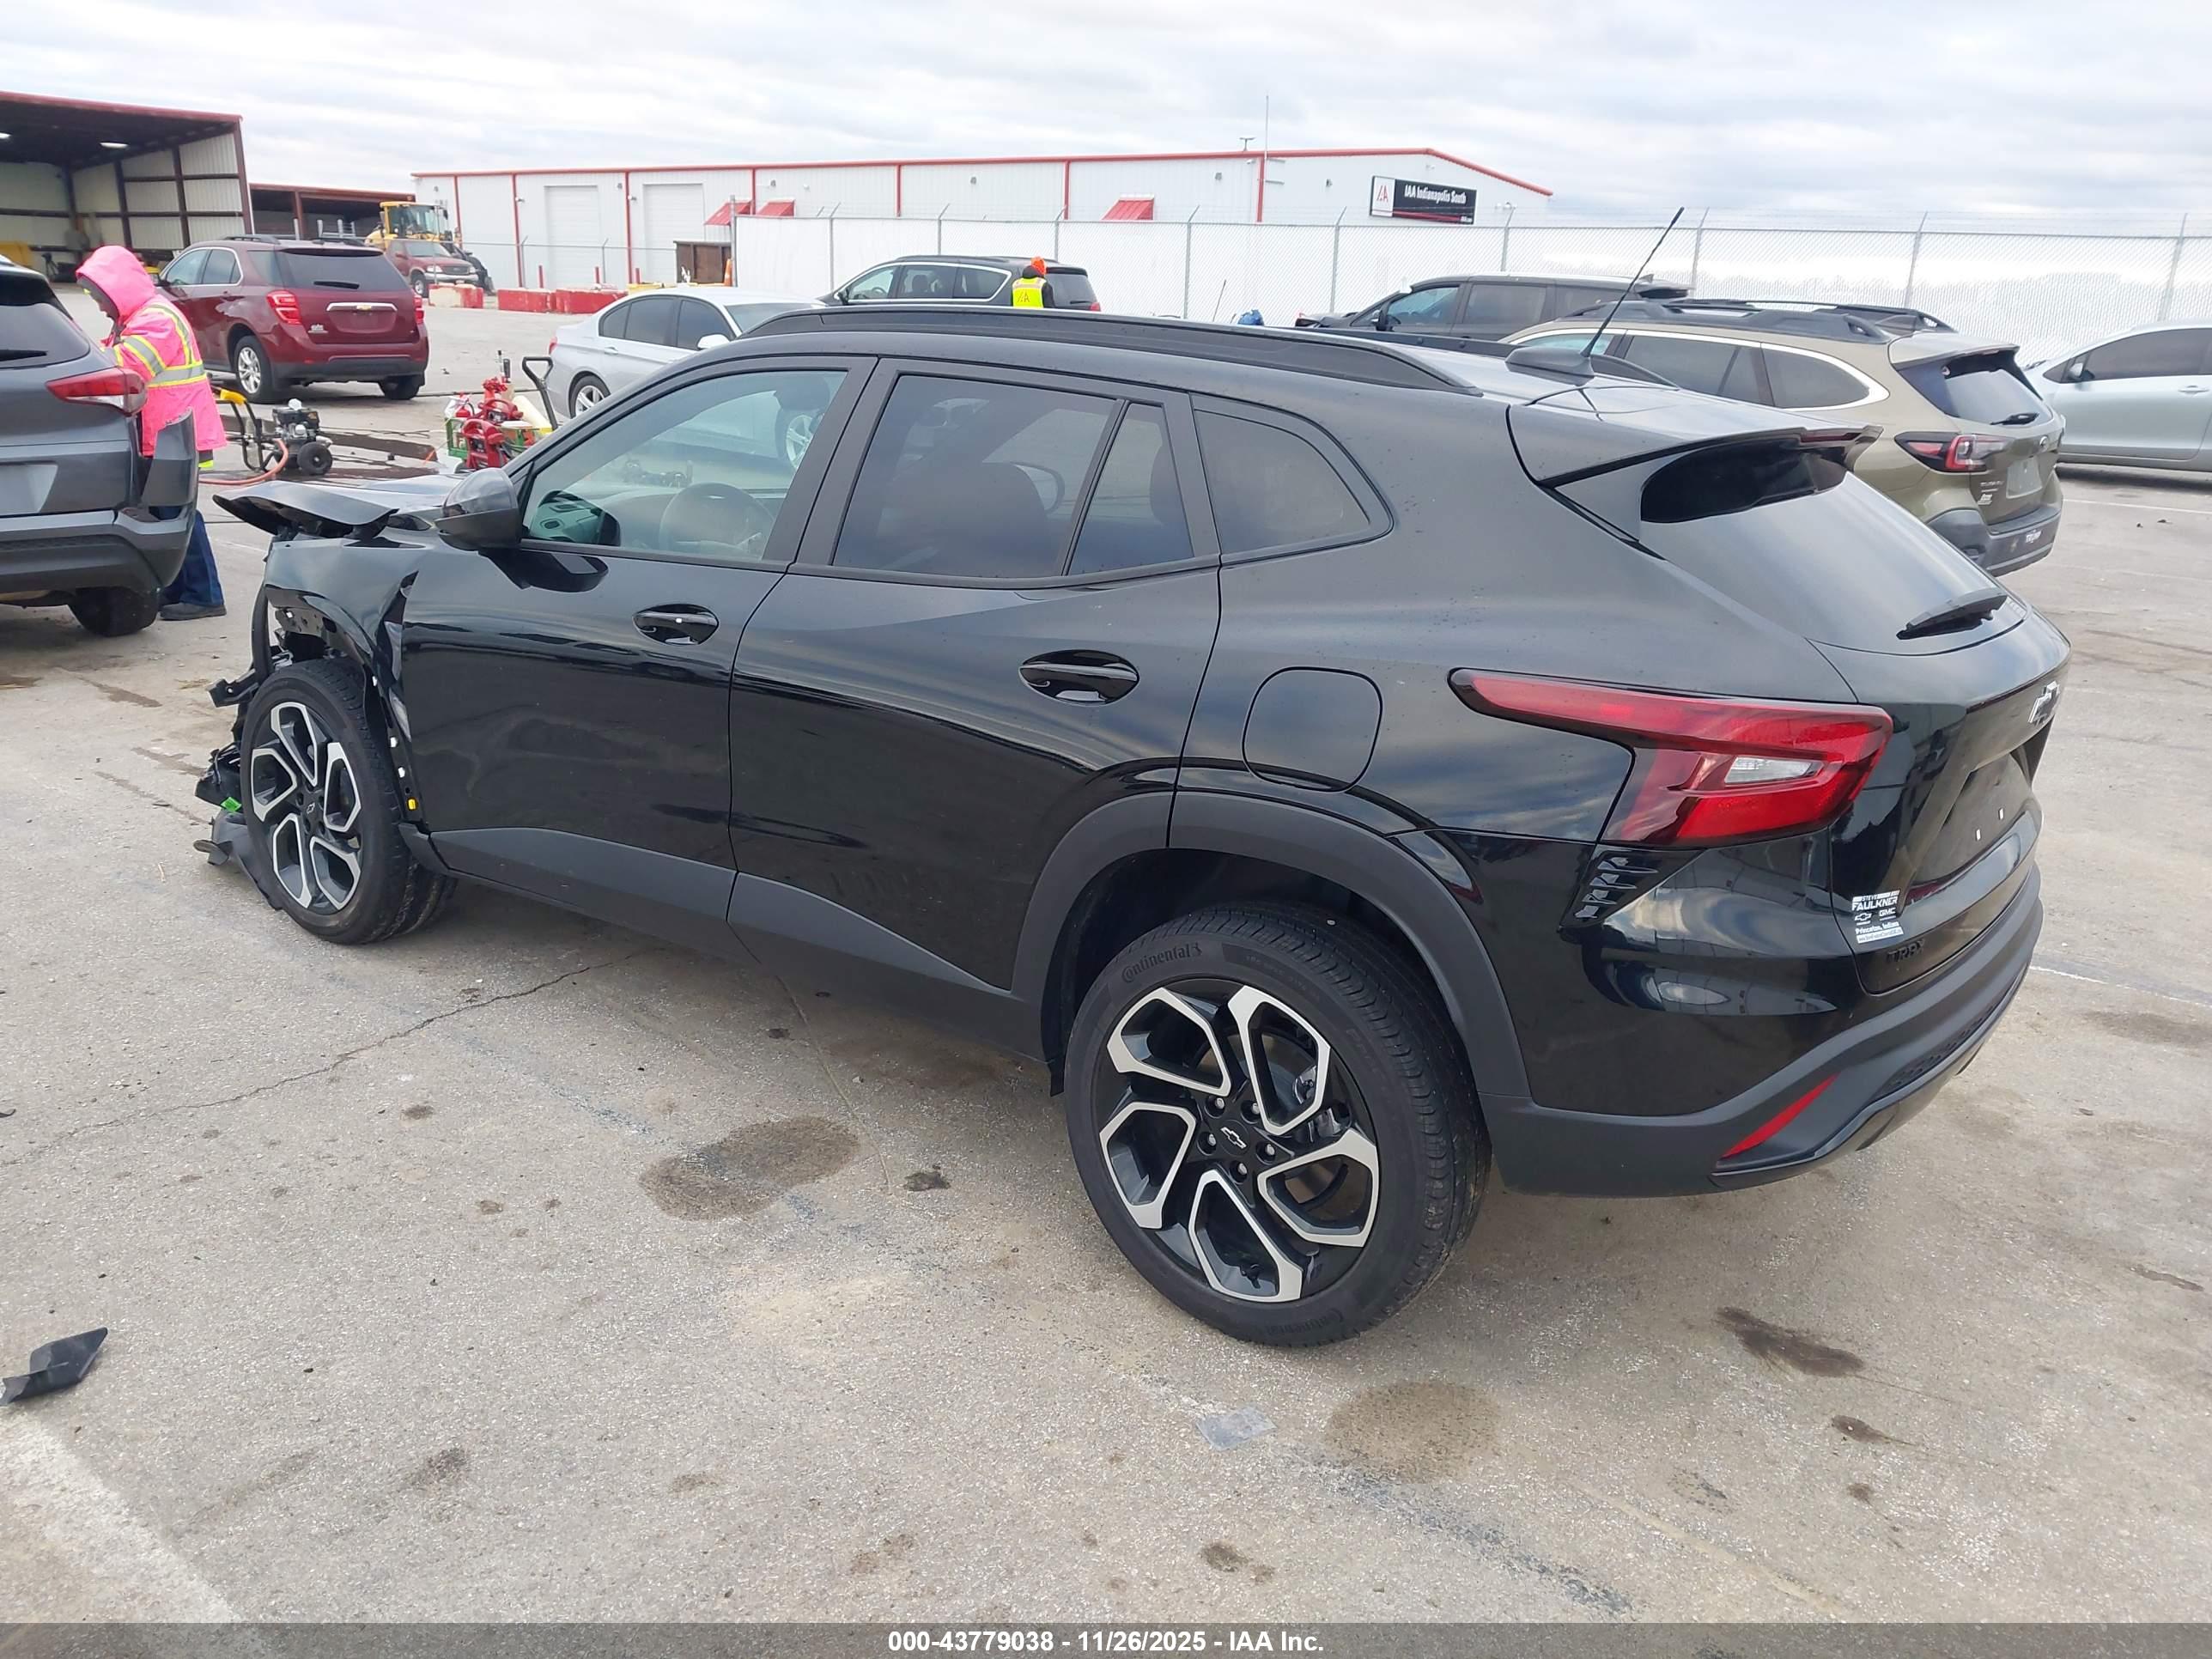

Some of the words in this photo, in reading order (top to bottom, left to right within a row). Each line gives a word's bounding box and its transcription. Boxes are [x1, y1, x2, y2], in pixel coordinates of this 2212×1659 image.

[1404, 185, 1416, 198] IAA
[1417, 187, 1450, 204] Indianapolis
[1450, 190, 1467, 204] South
[1852, 896, 1899, 911] FAULKNER
[1879, 907, 1896, 917] GMC
[1121, 943, 1191, 983] Continental
